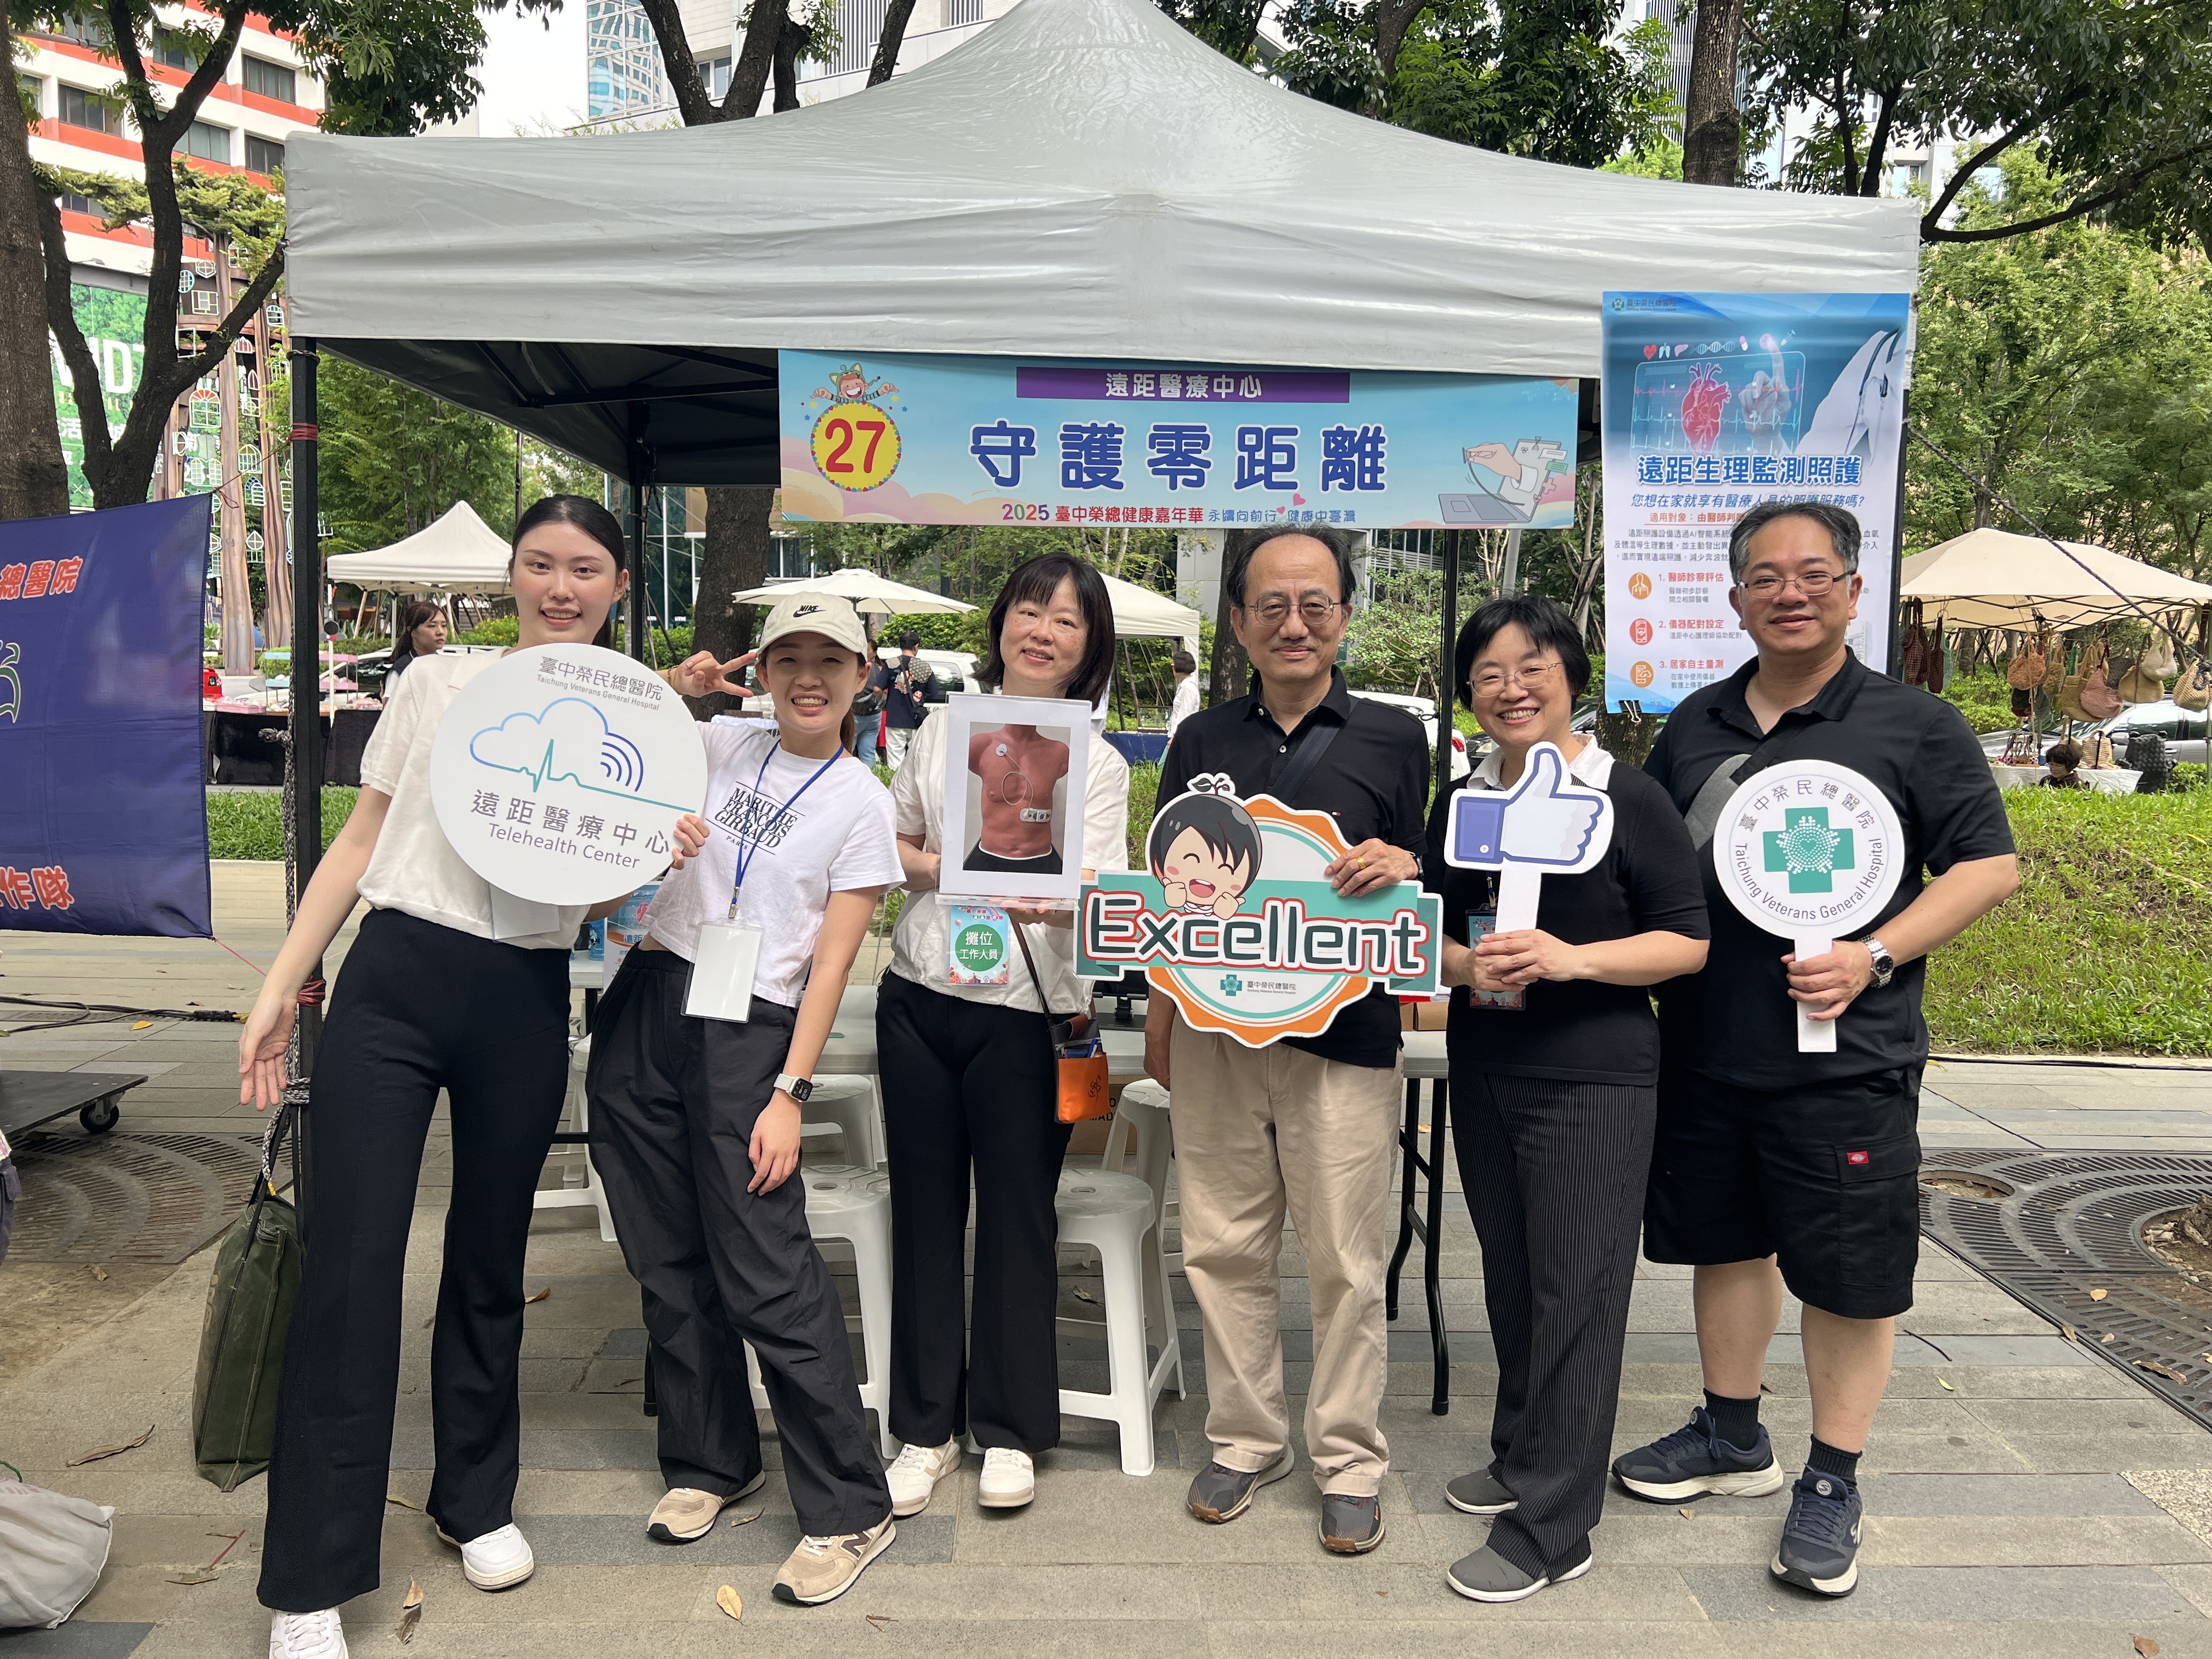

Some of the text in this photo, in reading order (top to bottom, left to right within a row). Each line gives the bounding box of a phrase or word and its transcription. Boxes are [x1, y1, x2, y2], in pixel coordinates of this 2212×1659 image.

[1105, 373, 1261, 398] 遠距醫療中心
[825, 417, 884, 474] 27
[971, 422, 1385, 492] 守護零距離
[1638, 455, 1862, 485] 遠距生理監測照護
[1002, 504, 1049, 521] 2025
[1056, 506, 1204, 523] 臺中榮總健康嘉年華
[539, 656, 663, 701] 臺中榮民總醫院
[1670, 659, 1723, 668] 居家自主量測
[537, 675, 659, 711] Taichung Veterans General Hospital
[471, 790, 669, 855] 遠距醫療中心
[1739, 780, 1876, 832] 臺中榮民總醫院
[489, 823, 640, 868] Telehealth Center
[715, 810, 781, 848] GIRBAUD
[1735, 838, 1883, 920] Taichung Veterans General Hospital
[966, 932, 992, 945] 攤位
[1091, 896, 1421, 969] Excellent
[960, 949, 998, 960] 工作人員
